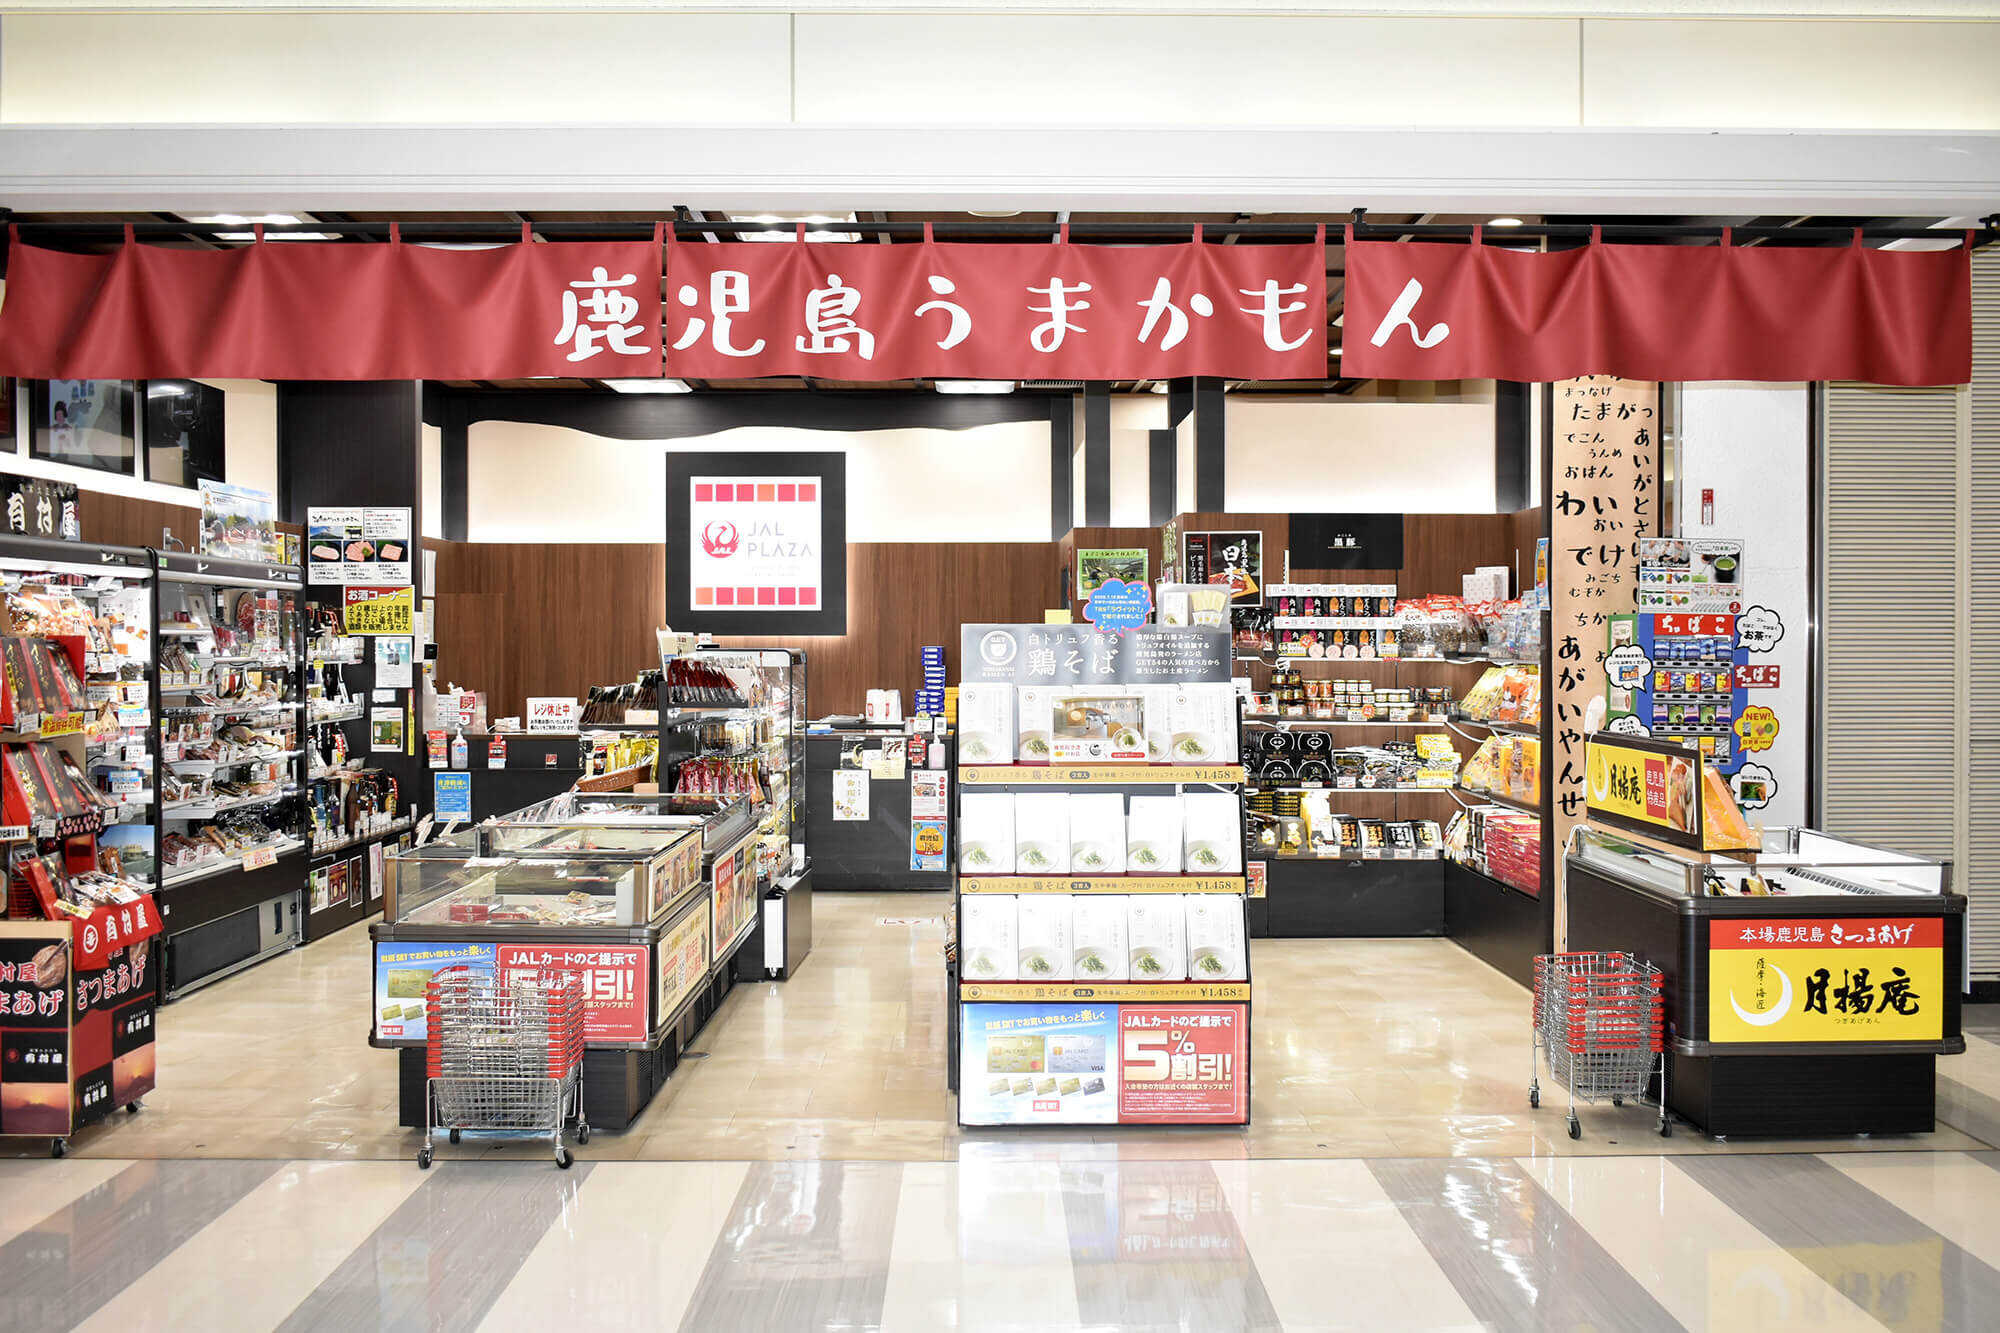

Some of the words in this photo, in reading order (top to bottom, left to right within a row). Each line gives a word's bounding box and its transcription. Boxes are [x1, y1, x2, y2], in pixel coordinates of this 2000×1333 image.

[554, 266, 1450, 362] 鹿児島うまかもん
[1565, 465, 1613, 479] おはん
[1556, 490, 1618, 516] わい
[747, 521, 784, 536] JAL
[1593, 519, 1623, 532] おい
[747, 542, 813, 557] PLAZA
[1567, 544, 1625, 568] でけ
[348, 589, 409, 601] お酒コーナー
[1028, 633, 1119, 645] 白トリュフ香る
[1027, 648, 1119, 676] 鶏そば
[534, 703, 570, 716] レジ休止中
[1746, 712, 1771, 720] NEW!
[1557, 635, 1585, 817] あがいやんせ
[1611, 763, 1641, 805] 月揚庵
[106, 904, 149, 942] 有村屋
[1740, 926, 1825, 943] 本場鹿児島
[1830, 923, 1915, 945] さつまあげ
[508, 951, 637, 966] JALカードのご提示で
[77, 955, 147, 1012] さつまあげ
[1803, 966, 1921, 1015] 月揚庵
[1124, 1015, 1232, 1027] JALカードのご提示で
